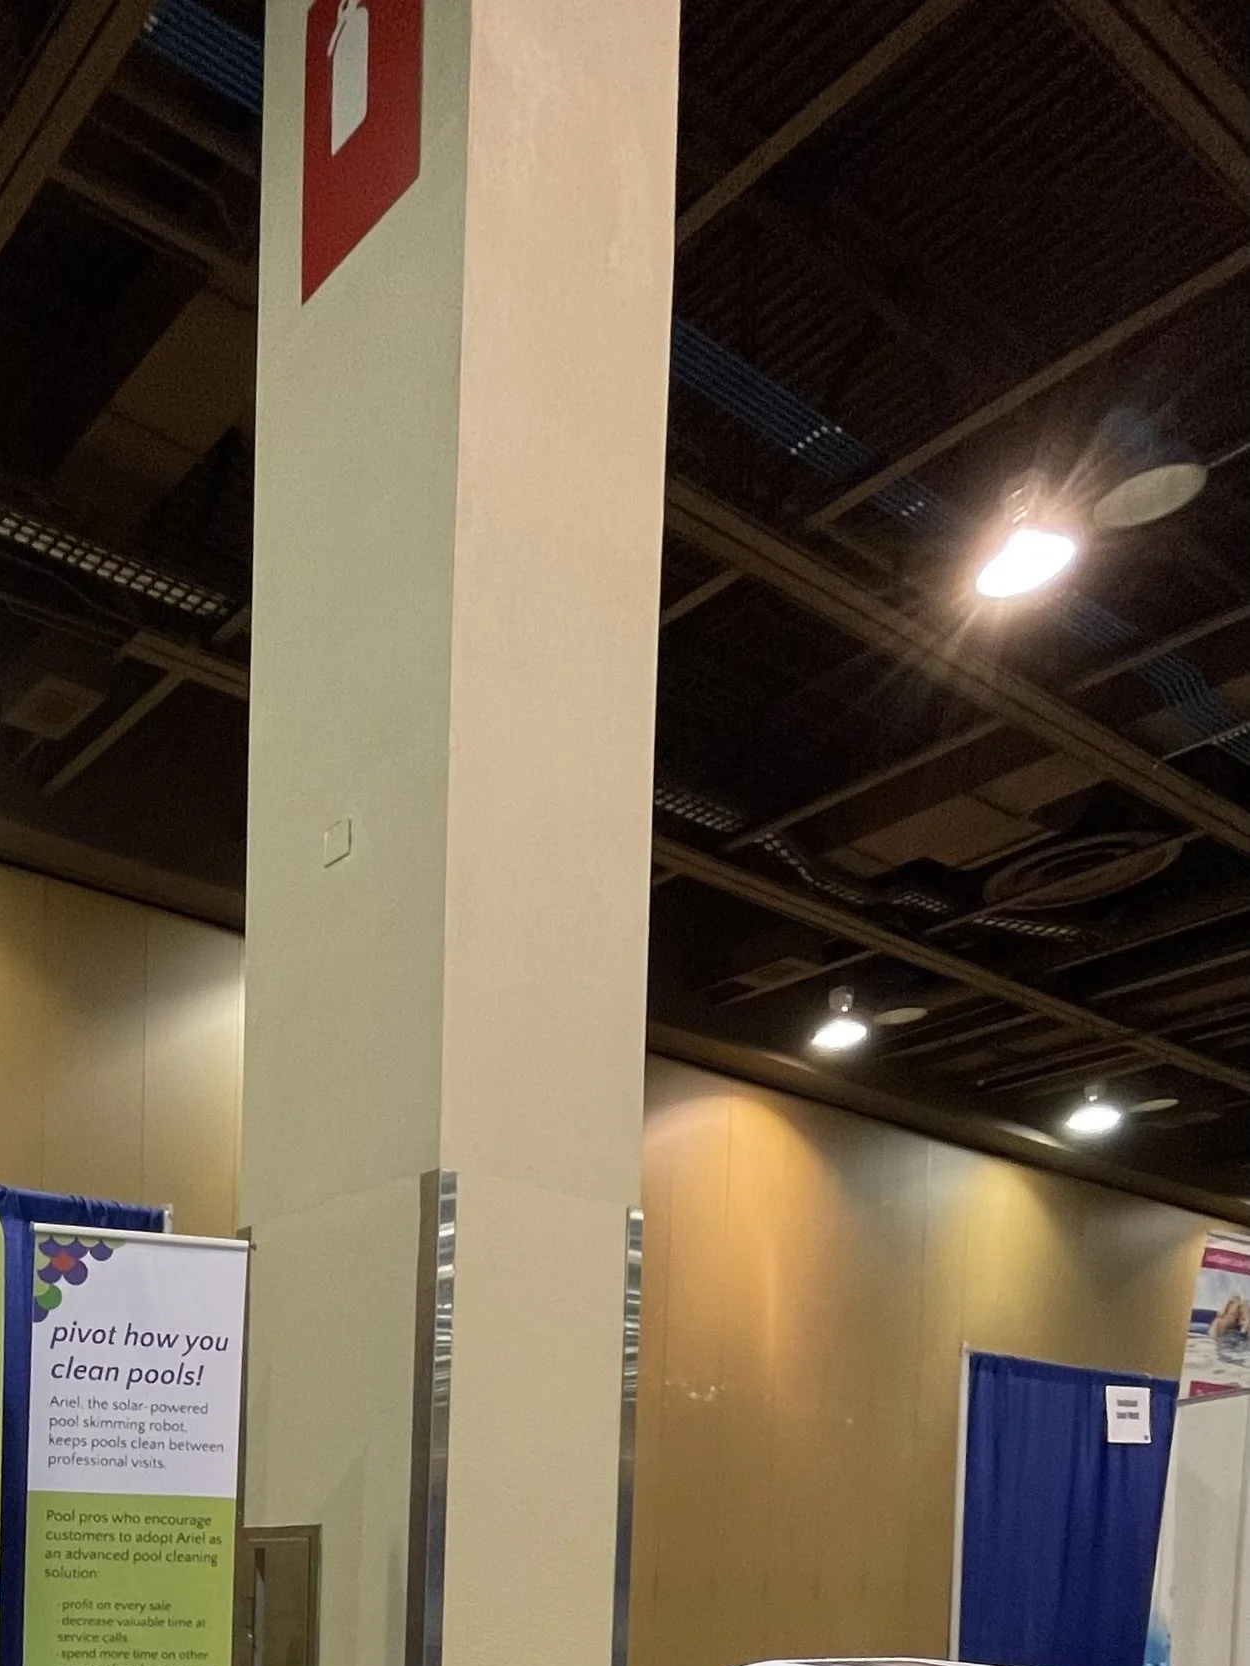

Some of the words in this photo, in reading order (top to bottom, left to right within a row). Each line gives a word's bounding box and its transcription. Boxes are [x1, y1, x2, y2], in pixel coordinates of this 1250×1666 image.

[50, 1321, 117, 1349] pivot
[124, 1322, 180, 1349] how
[181, 1336, 229, 1357] you
[50, 1356, 119, 1382] clean
[126, 1361, 205, 1390] pools!
[87, 1397, 108, 1410] the
[112, 1398, 209, 1416] solar-powered
[49, 1414, 79, 1432] pool
[83, 1416, 145, 1434] skimming
[48, 1432, 88, 1449] keeps
[91, 1434, 127, 1450] pools
[130, 1436, 165, 1451] clean
[168, 1438, 225, 1453] between
[47, 1453, 128, 1469] professional
[46, 1509, 76, 1523] Pool
[79, 1512, 109, 1526] pros
[111, 1511, 141, 1525] who
[144, 1515, 212, 1530] encourage
[45, 1530, 116, 1543] customers
[119, 1532, 132, 1543] to
[135, 1531, 174, 1546] adopt
[176, 1532, 206, 1545] Ariel
[208, 1535, 222, 1545] as
[44, 1550, 62, 1560] an
[64, 1549, 129, 1562] advanced
[132, 1550, 163, 1565] pool
[165, 1551, 218, 1568] cleaning
[61, 1599, 93, 1612] profit
[96, 1601, 112, 1611] on
[114, 1601, 147, 1613] every
[149, 1600, 172, 1612] sale
[61, 1616, 115, 1628] decrease
[116, 1616, 165, 1628] valuable
[167, 1616, 193, 1628] time
[196, 1618, 206, 1628] at
[57, 1631, 100, 1643] service
[102, 1631, 128, 1644] calls
[60, 1648, 97, 1661] spend
[99, 1651, 130, 1661] more
[132, 1650, 159, 1661] time
[161, 1651, 176, 1661] on
[178, 1649, 209, 1661] other
